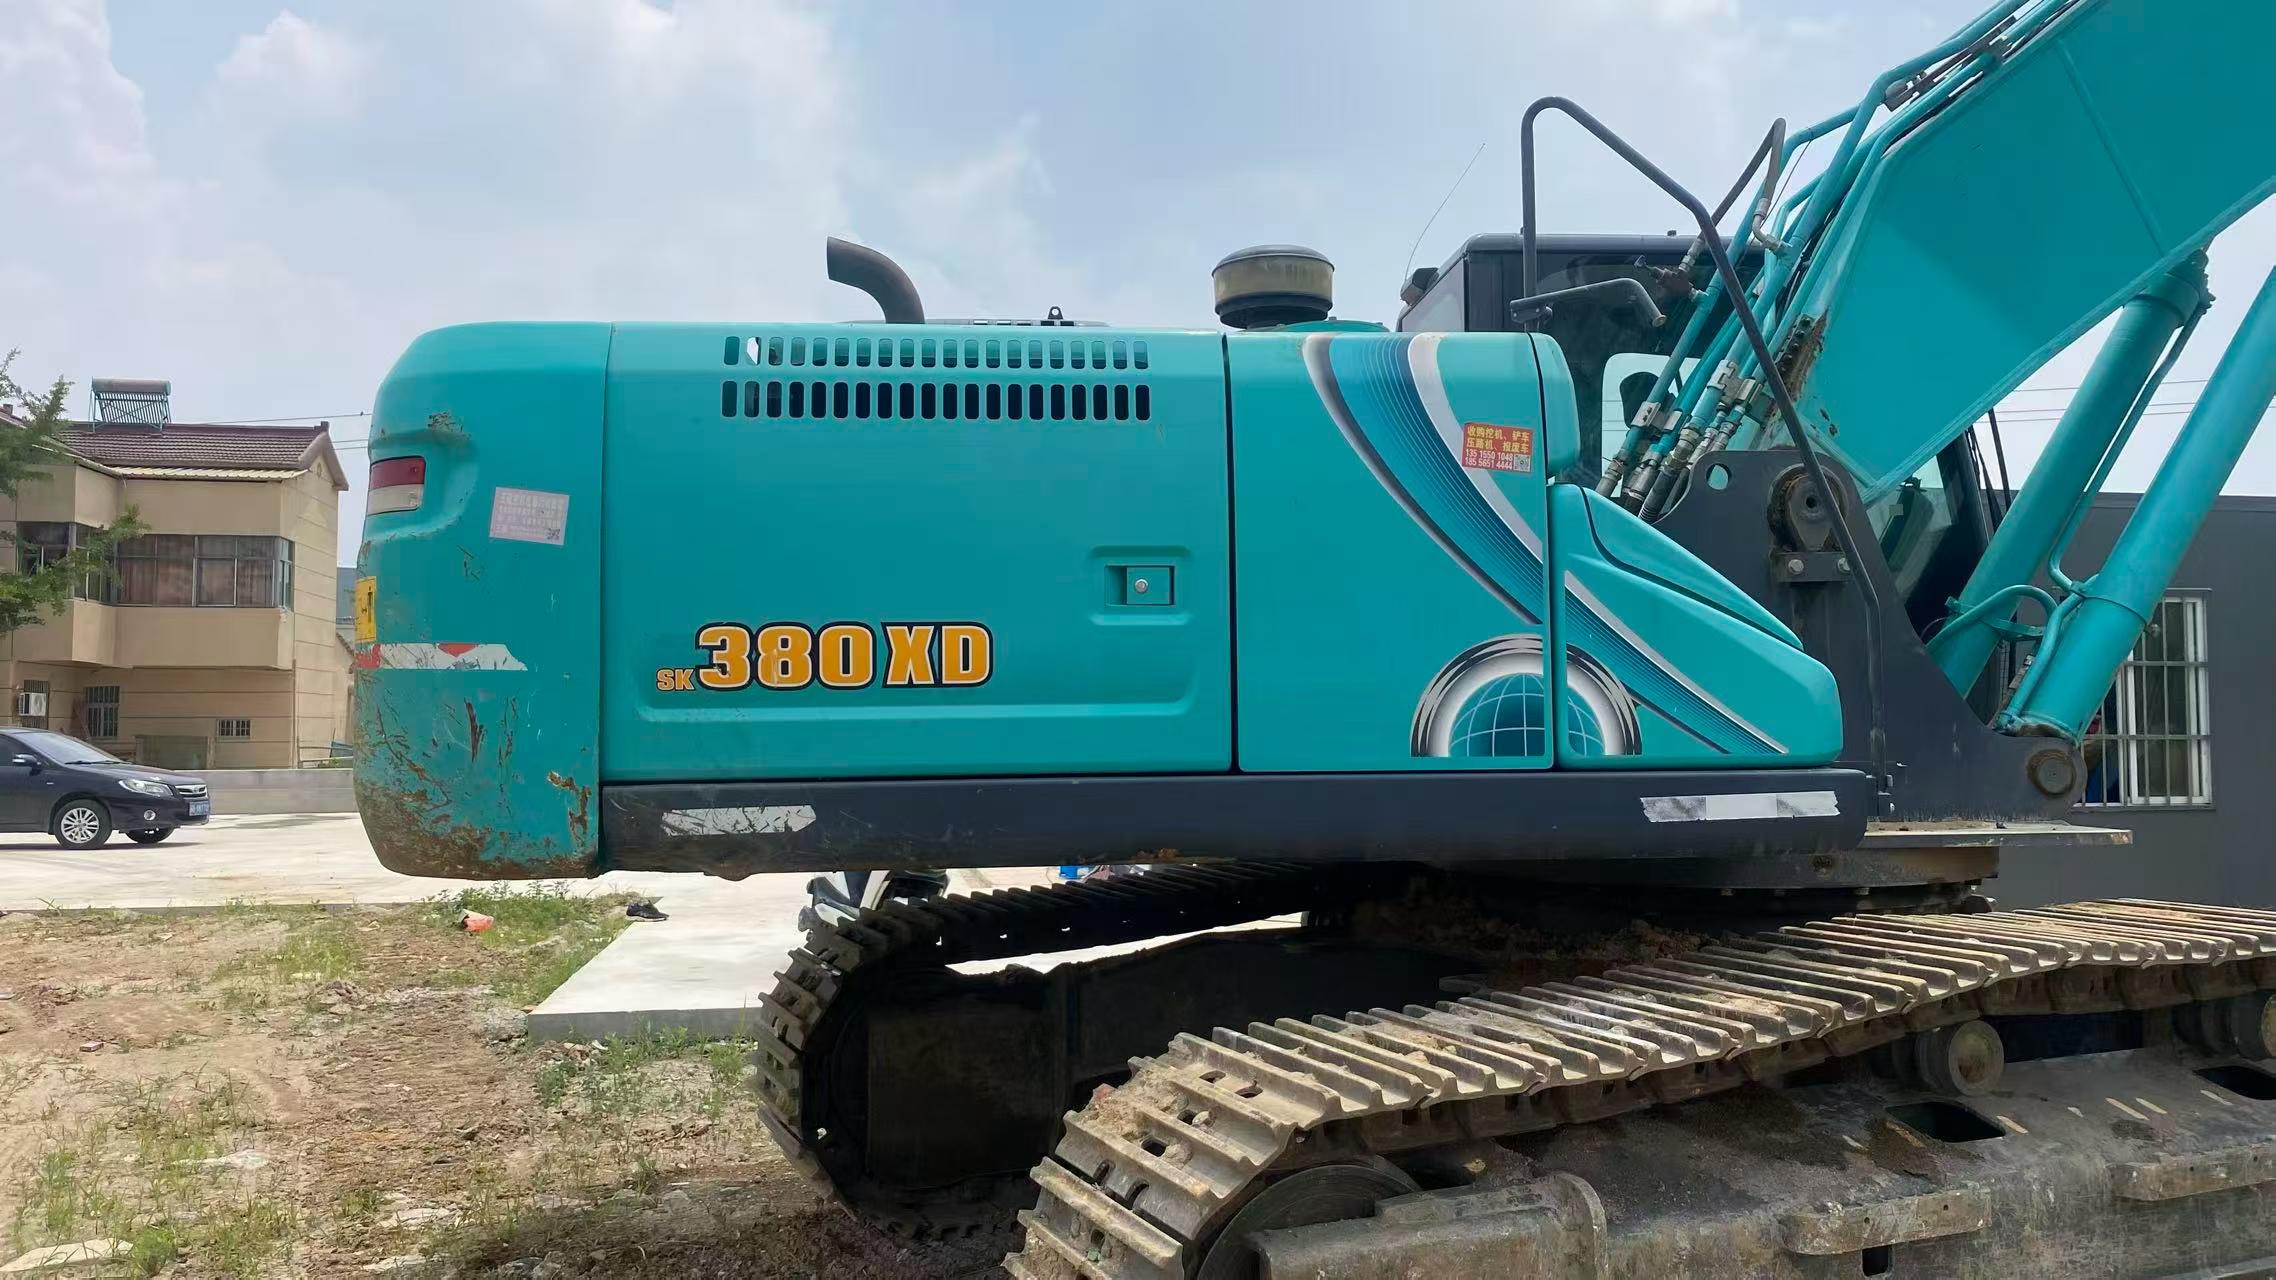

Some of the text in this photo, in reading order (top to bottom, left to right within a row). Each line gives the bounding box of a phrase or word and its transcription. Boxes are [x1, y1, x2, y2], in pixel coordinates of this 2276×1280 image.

[1466, 449, 1477, 458] 135
[1479, 450, 1495, 459] 1550
[1496, 461, 1513, 470] 4444
